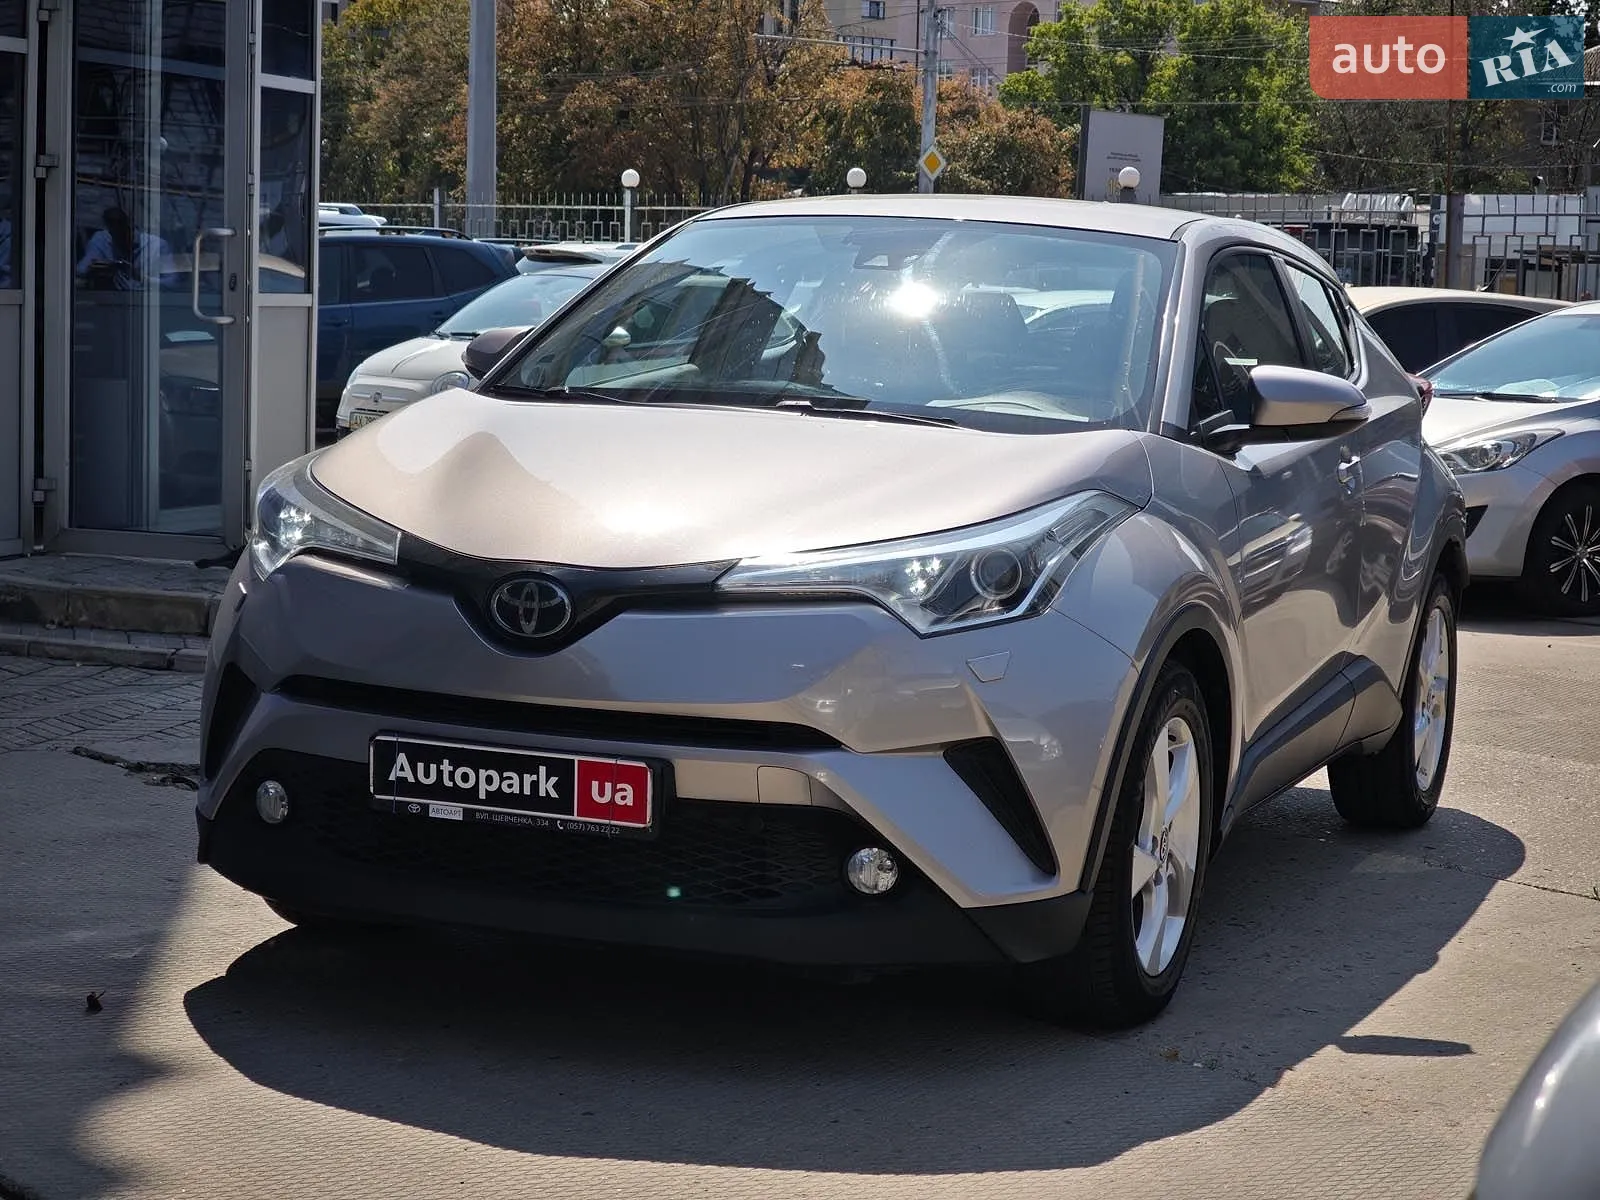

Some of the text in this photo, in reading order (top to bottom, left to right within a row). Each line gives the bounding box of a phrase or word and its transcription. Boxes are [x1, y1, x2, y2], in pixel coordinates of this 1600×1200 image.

[388, 752, 560, 799] Autopark
[590, 780, 634, 806] ua
[587, 823, 601, 834] 763
